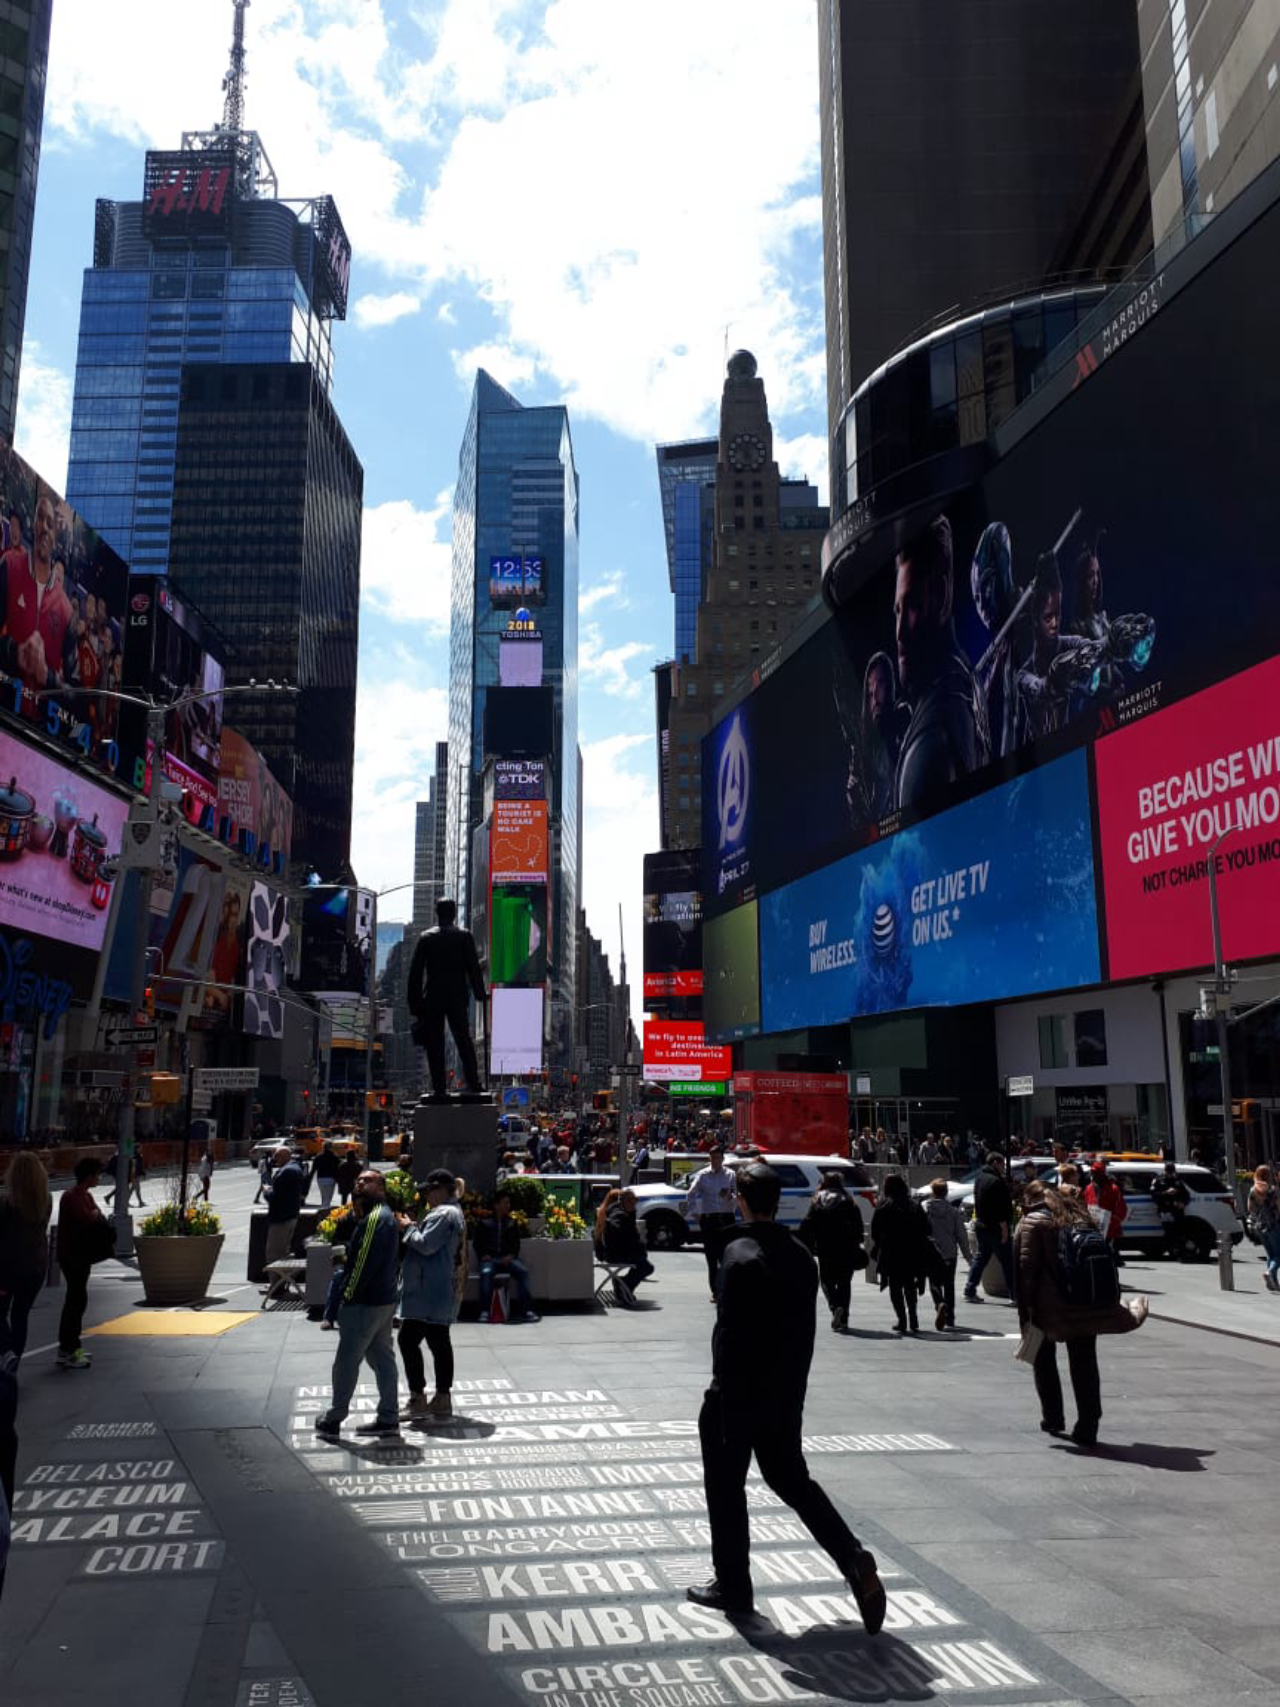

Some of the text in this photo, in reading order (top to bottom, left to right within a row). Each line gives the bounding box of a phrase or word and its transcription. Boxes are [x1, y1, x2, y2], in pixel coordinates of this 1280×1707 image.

[1103, 272, 1164, 341] MARRIOTT
[1103, 299, 1158, 358] MARQUIS
[492, 561, 542, 578] 12:53
[130, 614, 148, 627] LG
[507, 620, 535, 631] 2018
[1118, 681, 1163, 711] MARRIOTT
[1119, 697, 1158, 723] MARQUIS
[508, 774, 539, 783] TDK
[1138, 750, 1245, 821] BECAUSE
[1127, 786, 1280, 864] GIVE YOU MO
[1143, 870, 1166, 893] NOT
[1226, 846, 1256, 871] YOU
[911, 859, 990, 914] GET LIVE TV
[809, 918, 828, 949] BUY
[912, 915, 931, 947] ON
[809, 938, 857, 975] WIRELESS.
[664, 1033, 675, 1043] fly
[665, 1050, 687, 1058] Latin
[24, 1460, 174, 1484] BELASCO
[328, 1470, 489, 1486] MUSIC BOX
[336, 1480, 493, 1497] MARQUIS
[427, 1488, 656, 1523] FONTANNE
[11, 1510, 201, 1542] ALACE
[386, 1519, 665, 1545] ETHEL BARRYMORE
[84, 1541, 218, 1575] CORT
[399, 1534, 677, 1559] LONGACRE
[480, 1559, 660, 1599] KERR
[520, 1658, 716, 1694] CIRCLE
[719, 1641, 1040, 1701] GERSHWIN
[543, 1681, 733, 1707] IN THE SQUARE
